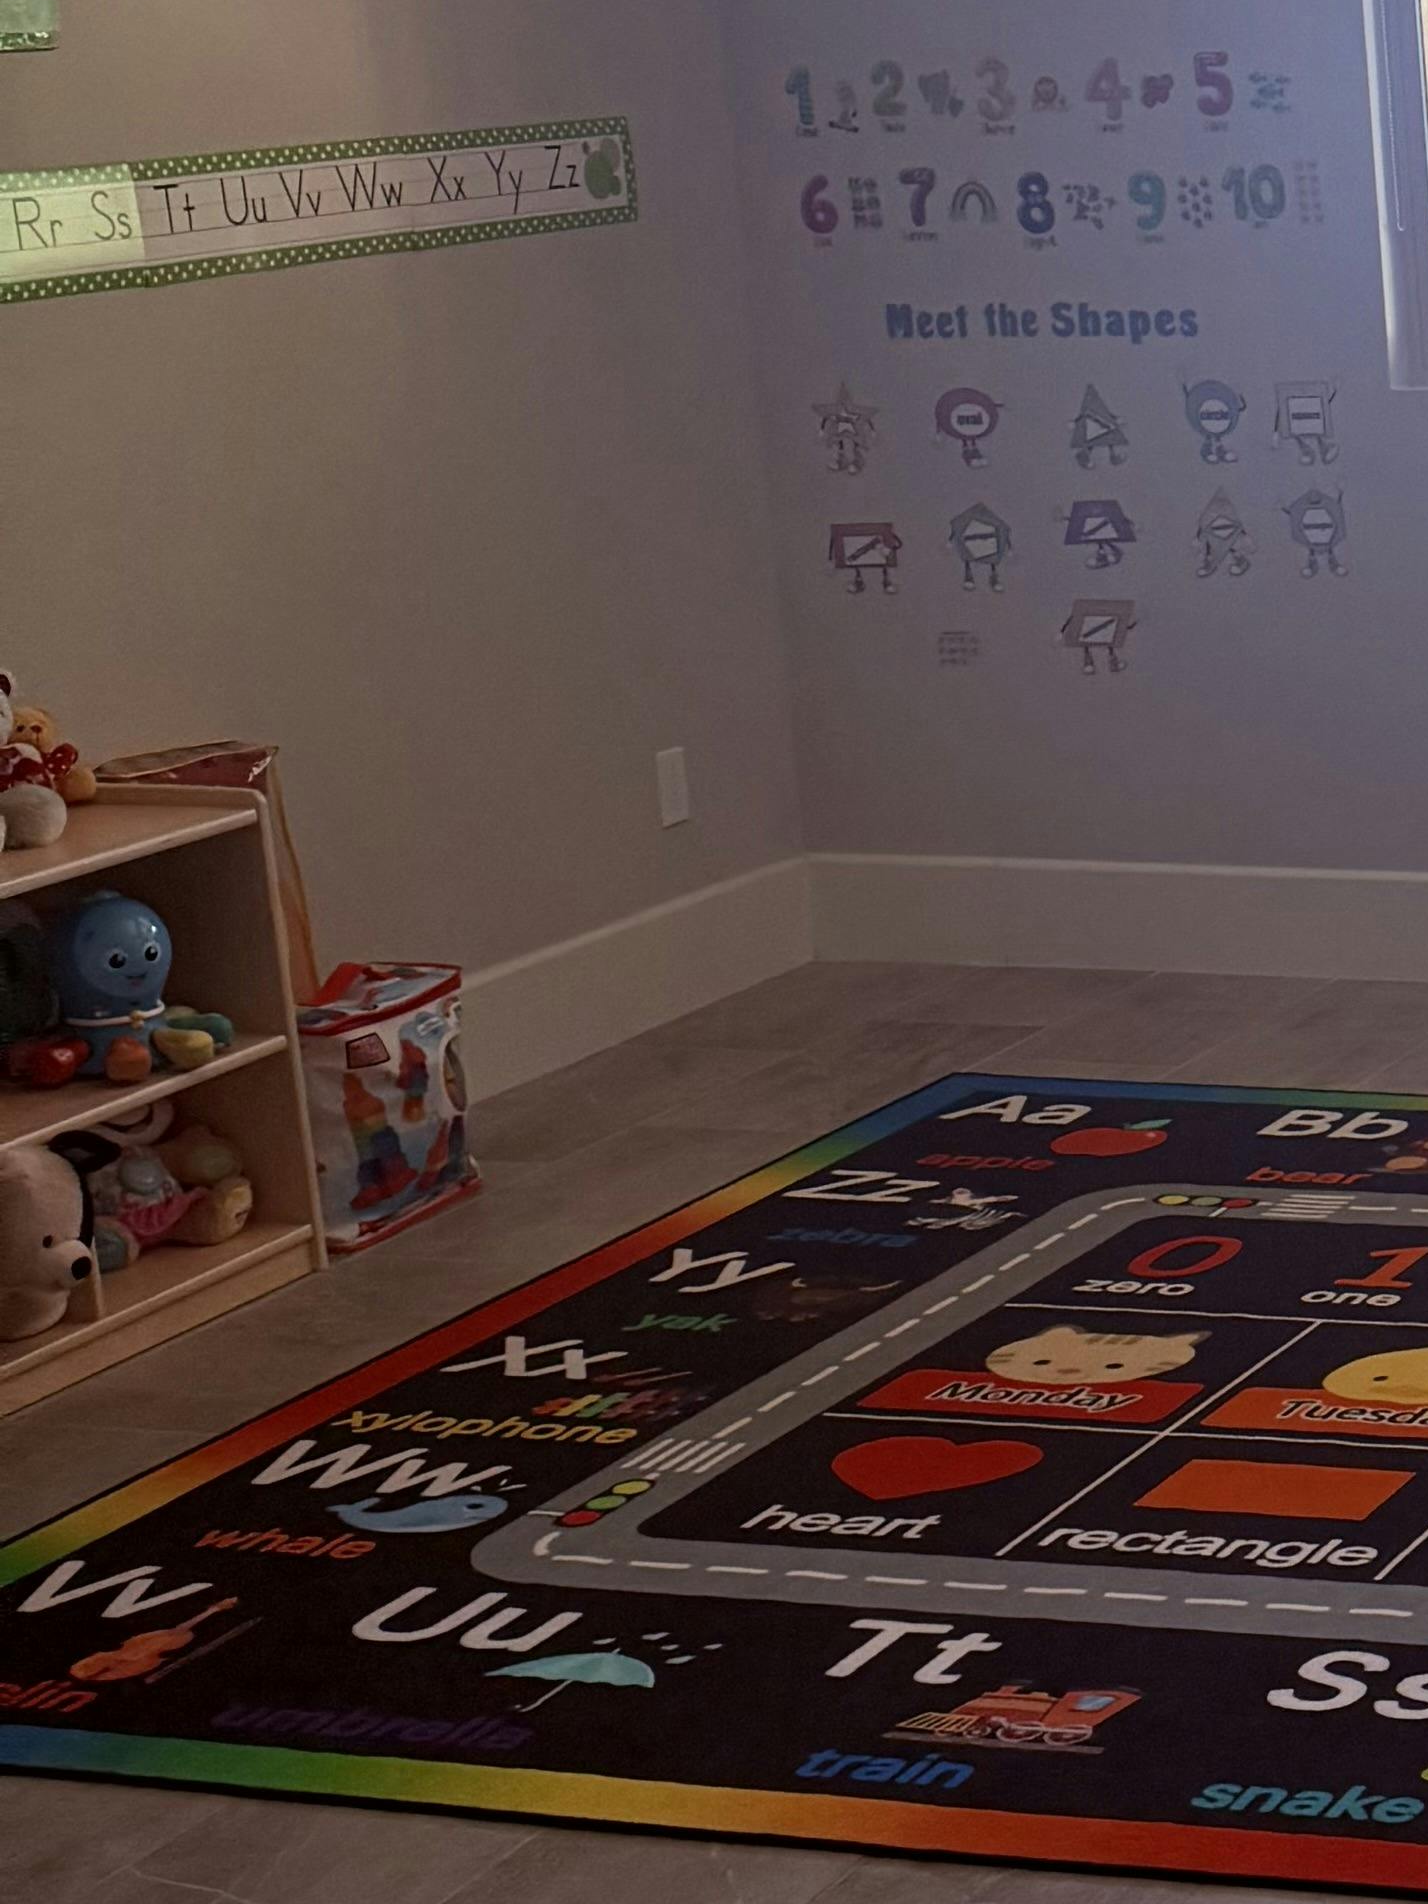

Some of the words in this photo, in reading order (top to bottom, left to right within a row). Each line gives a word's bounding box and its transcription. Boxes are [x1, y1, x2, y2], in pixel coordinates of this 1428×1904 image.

[785, 64, 815, 126] 1
[870, 60, 907, 117] 2
[975, 58, 1016, 121] 3
[1084, 57, 1131, 121] 4
[1193, 51, 1234, 117] 5
[12, 196, 63, 251] Rr
[90, 191, 134, 241] Ss
[152, 184, 195, 235] Tt
[220, 177, 268, 226] Uu
[278, 171, 322, 219] Vv
[335, 161, 403, 212] Ww
[426, 155, 466, 203] Xx
[484, 150, 523, 214] Yy
[543, 145, 580, 191] Zz
[800, 174, 839, 234] 6
[898, 167, 936, 227] 7
[1016, 171, 1055, 234] 8
[1127, 169, 1167, 230] 9
[1221, 164, 1286, 220] 10
[886, 302, 968, 340] Meet
[984, 302, 1041, 338] the
[1051, 302, 1198, 344] Shapes
[940, 1095, 1093, 1125] Aa
[1256, 1109, 1409, 1140] Bb
[916, 1152, 1055, 1171] apple
[1245, 1167, 1372, 1185] bear
[782, 1169, 940, 1203] Zz
[649, 1248, 796, 1293] Yy
[1127, 1235, 1243, 1278] 0
[1072, 1278, 1195, 1297] zero
[1300, 1289, 1402, 1307] one
[622, 1310, 738, 1333] yak
[441, 1335, 628, 1380] Xx
[928, 1381, 1143, 1411] Monday
[331, 1407, 638, 1446] xylophone
[251, 1440, 512, 1497] Ww
[195, 1526, 377, 1559] whale
[740, 1504, 943, 1540] heart
[1037, 1523, 1380, 1570] rectangle
[16, 1560, 214, 1619] Vv
[352, 1586, 583, 1653] Uu
[824, 1618, 1002, 1685] Tt
[795, 1747, 976, 1789] train
[1190, 1782, 1426, 1824] snake
